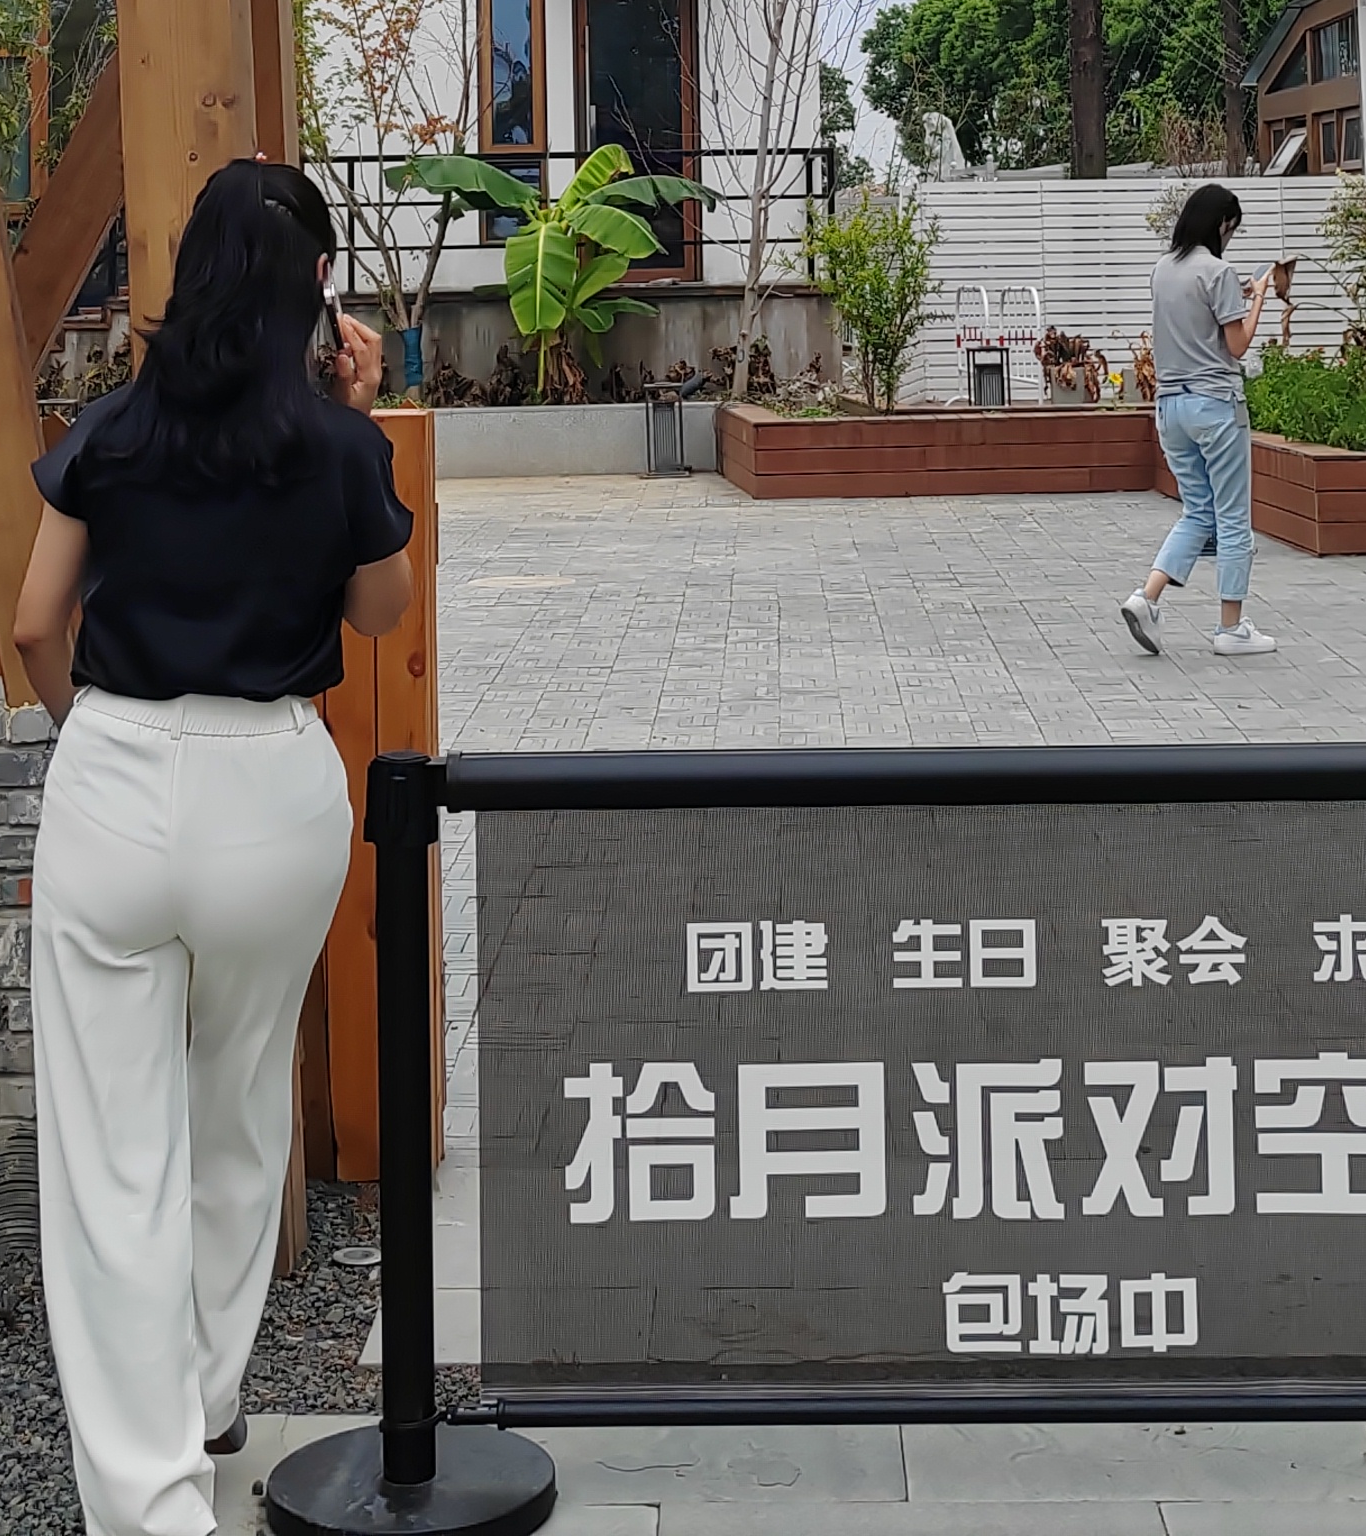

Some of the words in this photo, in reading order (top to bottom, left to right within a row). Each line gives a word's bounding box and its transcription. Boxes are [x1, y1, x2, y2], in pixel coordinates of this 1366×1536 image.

[686, 919, 829, 993] 团建
[892, 919, 1038, 989] 生日
[1100, 914, 1248, 988] 聚会
[941, 1271, 1200, 1355] 包场中
